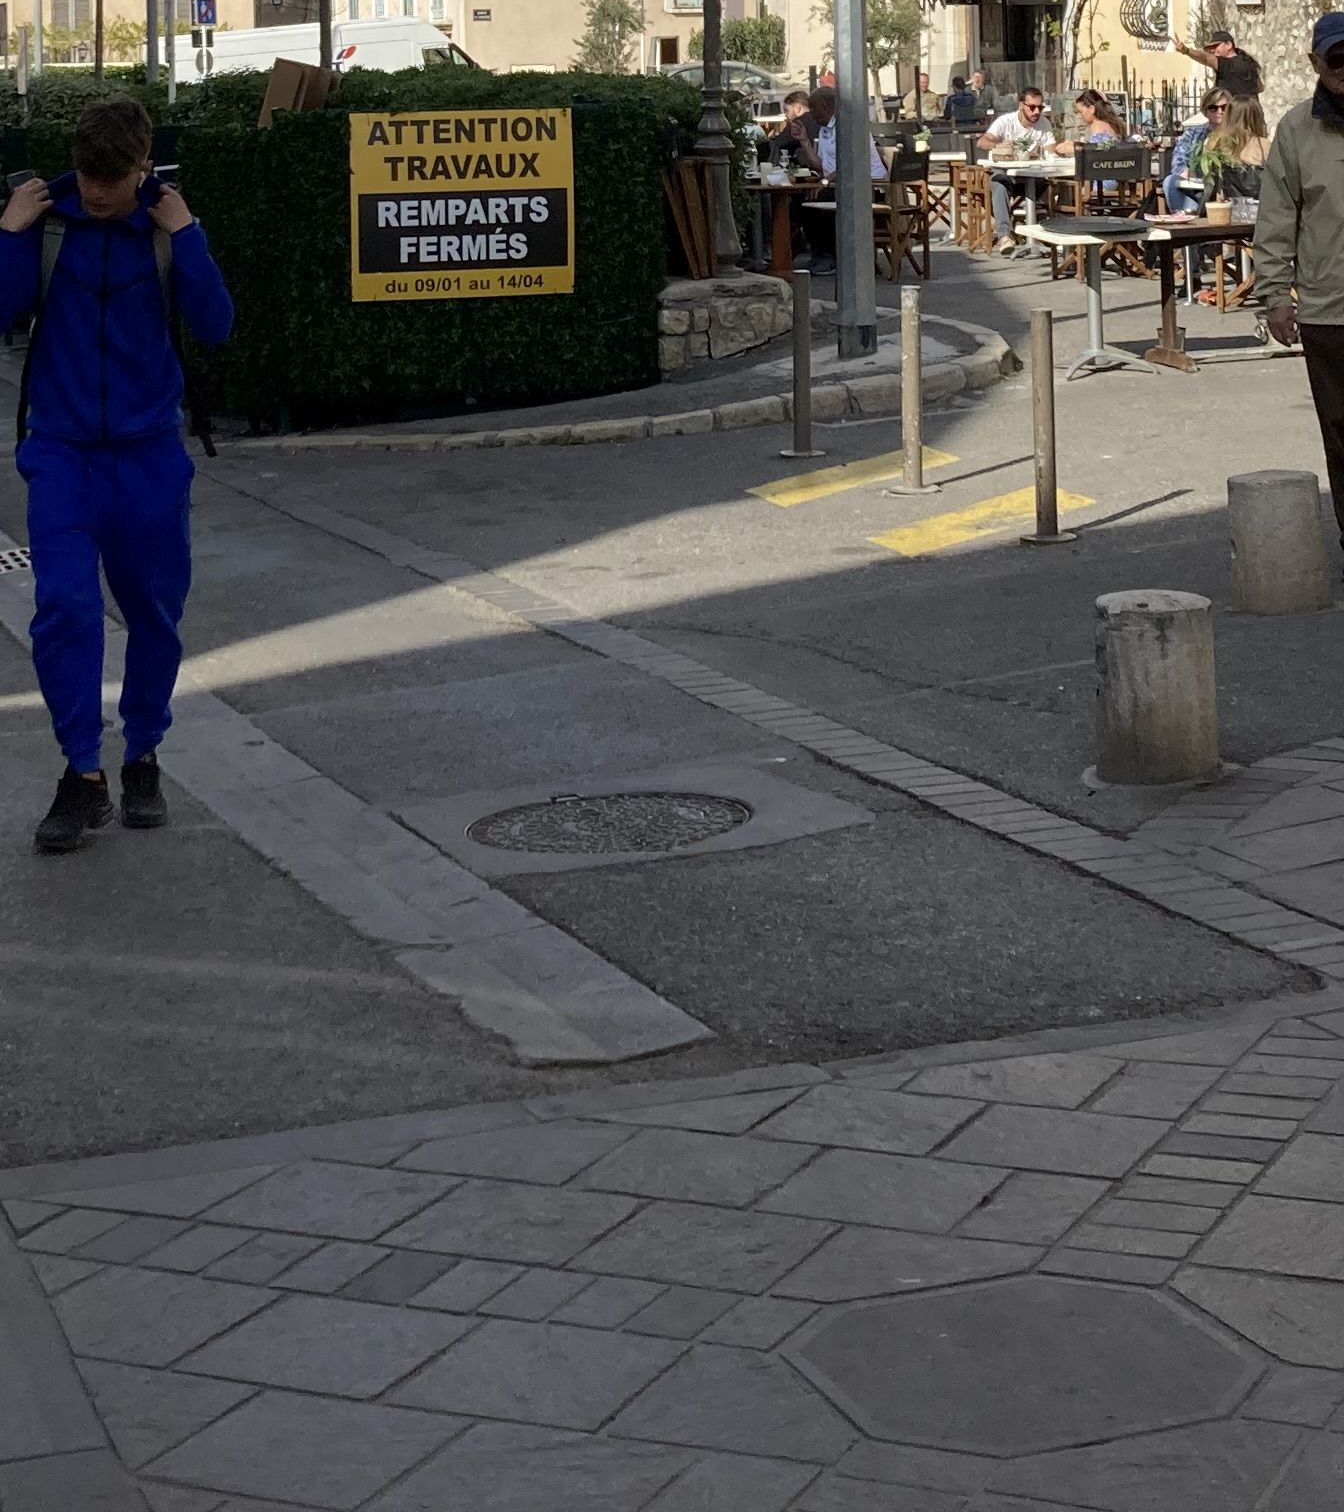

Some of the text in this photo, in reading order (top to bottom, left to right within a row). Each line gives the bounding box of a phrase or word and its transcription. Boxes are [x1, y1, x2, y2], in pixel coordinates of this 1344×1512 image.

[367, 116, 557, 146] ATTENTION
[383, 152, 540, 181] TRAVAUX
[377, 196, 549, 228] REMPARTS
[399, 227, 528, 263] FERMÉS
[385, 274, 544, 294] du 09/01 au 14/04
